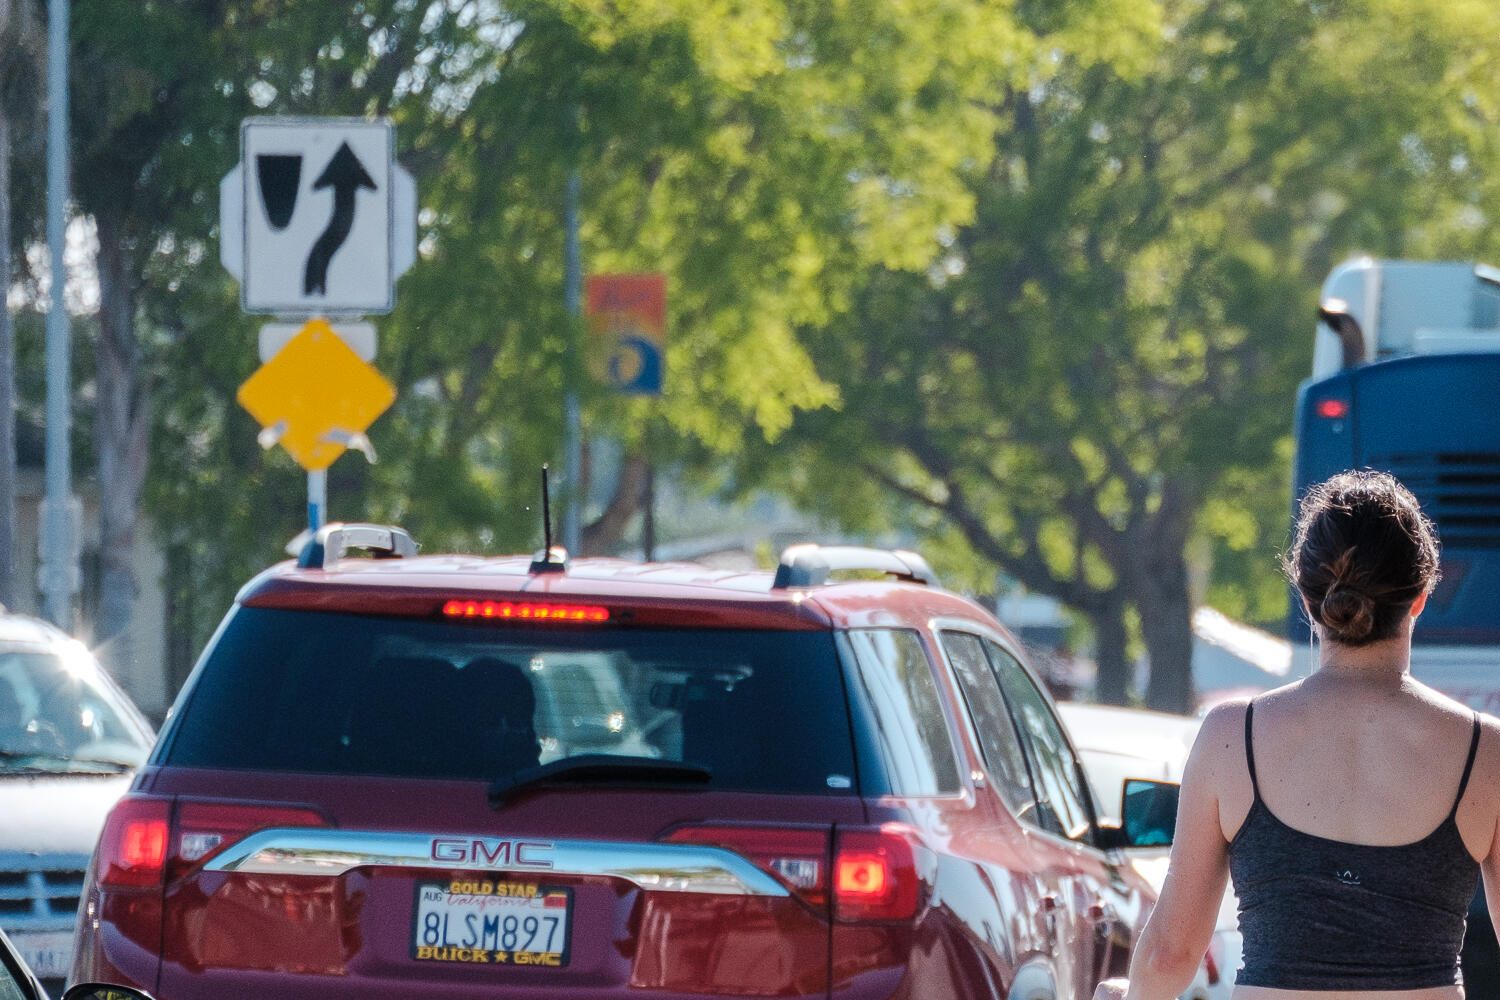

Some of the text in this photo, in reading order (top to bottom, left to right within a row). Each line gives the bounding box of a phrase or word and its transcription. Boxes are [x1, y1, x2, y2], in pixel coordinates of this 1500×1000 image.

[431, 838, 554, 869] GMC
[423, 891, 443, 902] AUG
[450, 879, 538, 898] GOLD STAR
[423, 911, 560, 953] 8LSM897
[416, 946, 562, 966] BUICK GMC
